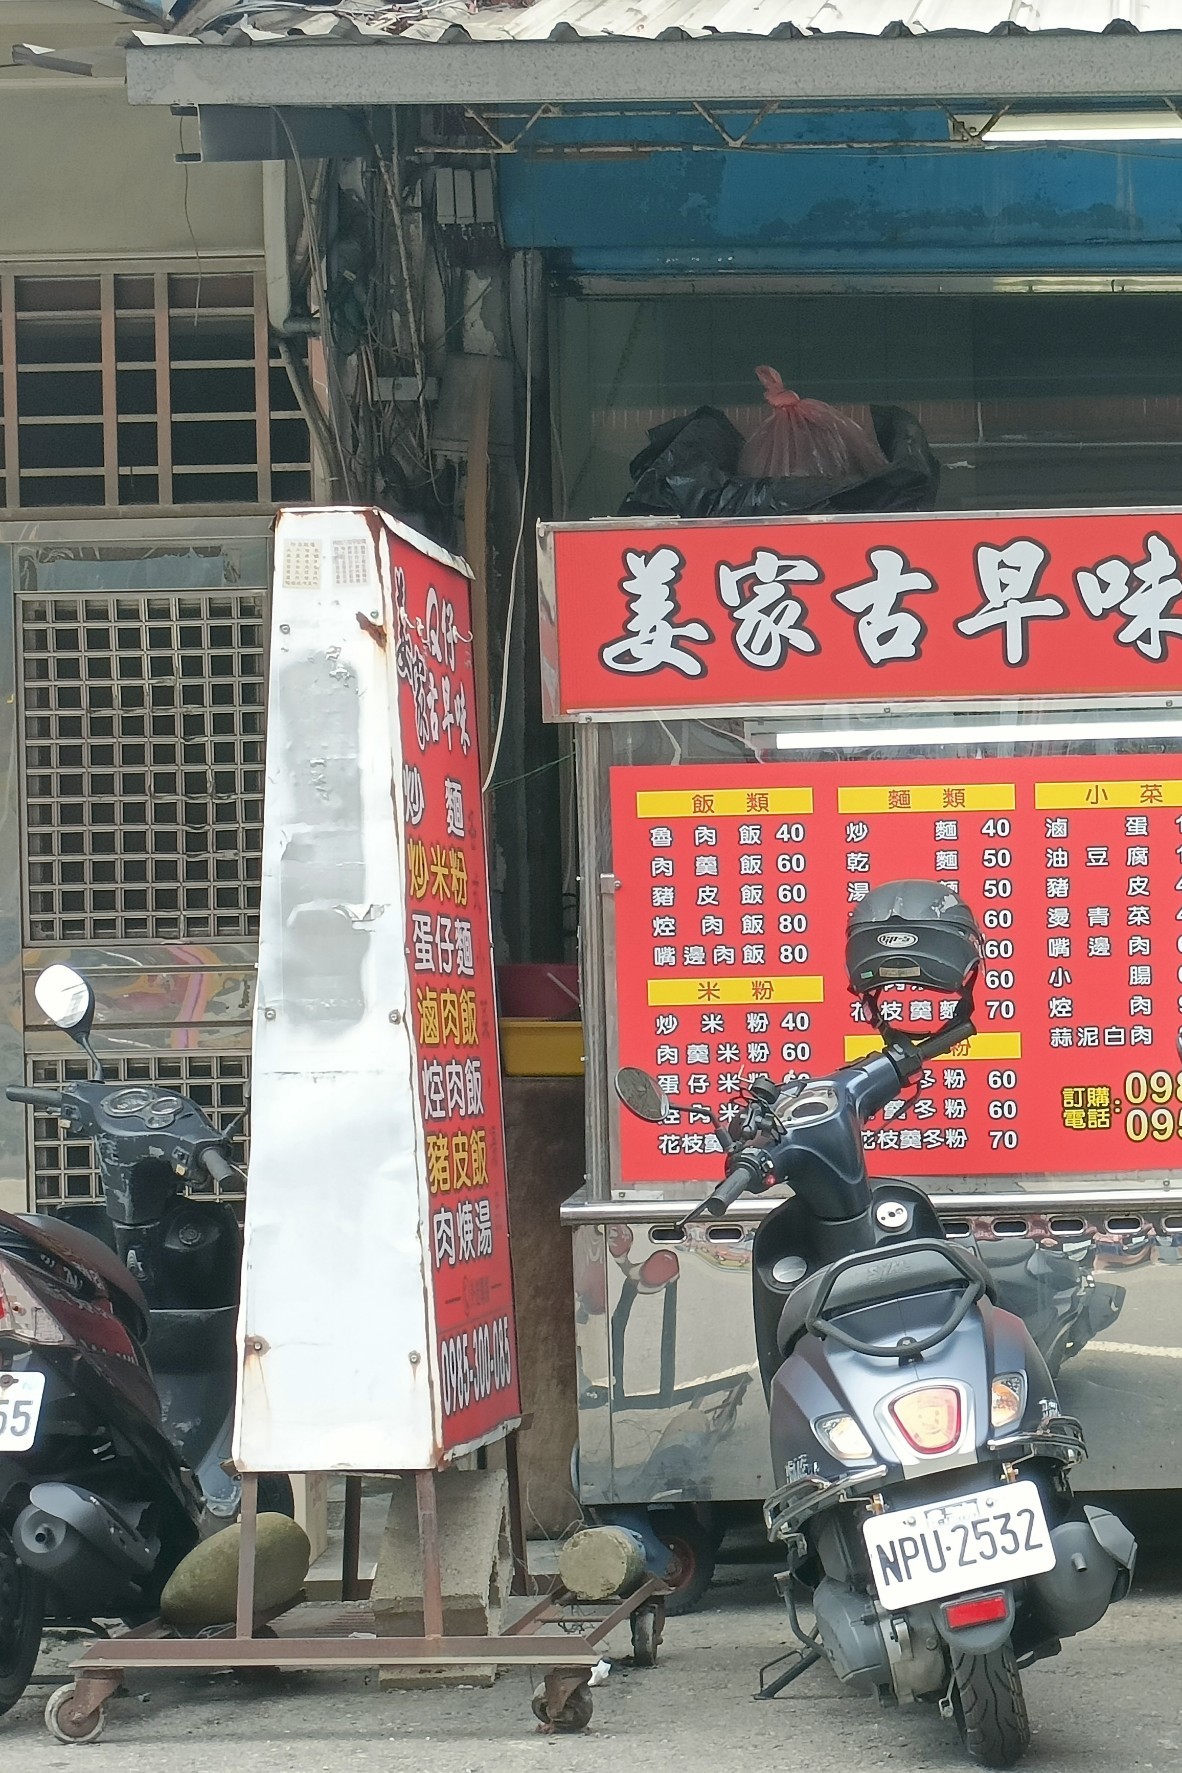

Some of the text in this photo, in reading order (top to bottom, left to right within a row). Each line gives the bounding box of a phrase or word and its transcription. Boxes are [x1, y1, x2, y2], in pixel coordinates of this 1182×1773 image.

[402, 764, 464, 837] 炒麵
[692, 793, 769, 814] 飯類
[888, 788, 966, 809] 麵類
[1086, 784, 1162, 805] 小菜
[650, 824, 804, 847] 魯肉飯 40
[846, 819, 1010, 843] 炒麵 40
[1046, 816, 1148, 838] 滷蛋
[652, 855, 805, 877] 肉羹飯 60
[847, 850, 1011, 872] 乾麵 50
[1046, 846, 1149, 867] 油豆腐
[407, 838, 467, 906] 炒米粉
[652, 885, 806, 906] 豬皮飯 60
[984, 880, 1011, 898] 50
[1047, 876, 1150, 898] 豬皮
[779, 916, 807, 933] 80
[985, 910, 1012, 928] 60
[1048, 906, 1150, 927] 燙青菜
[412, 913, 474, 976] 蛋仔麵
[985, 941, 1012, 958] 60
[1049, 936, 1150, 958] 嘴邊肉
[654, 945, 807, 966] 嘴邊肉飯 80
[986, 971, 1013, 989] 60
[1049, 966, 1151, 987] 小腸
[698, 980, 774, 1001] 米粉
[417, 986, 478, 1046] 滷肉飯
[987, 1001, 1014, 1019] 70
[656, 1013, 809, 1035] 炒米粉 40
[1050, 1025, 1152, 1047] 蒜泥白肉
[657, 1042, 810, 1064] 肉羹米粉 60
[989, 1071, 1016, 1088] 60
[1063, 1086, 1110, 1108] 訂購
[990, 1101, 1017, 1118] 60
[990, 1131, 1018, 1149] 70
[427, 1130, 488, 1194] 豬皮飯
[441, 1316, 511, 1416] 0985-300-085
[876, 1508, 1044, 1586] NPU-2532
